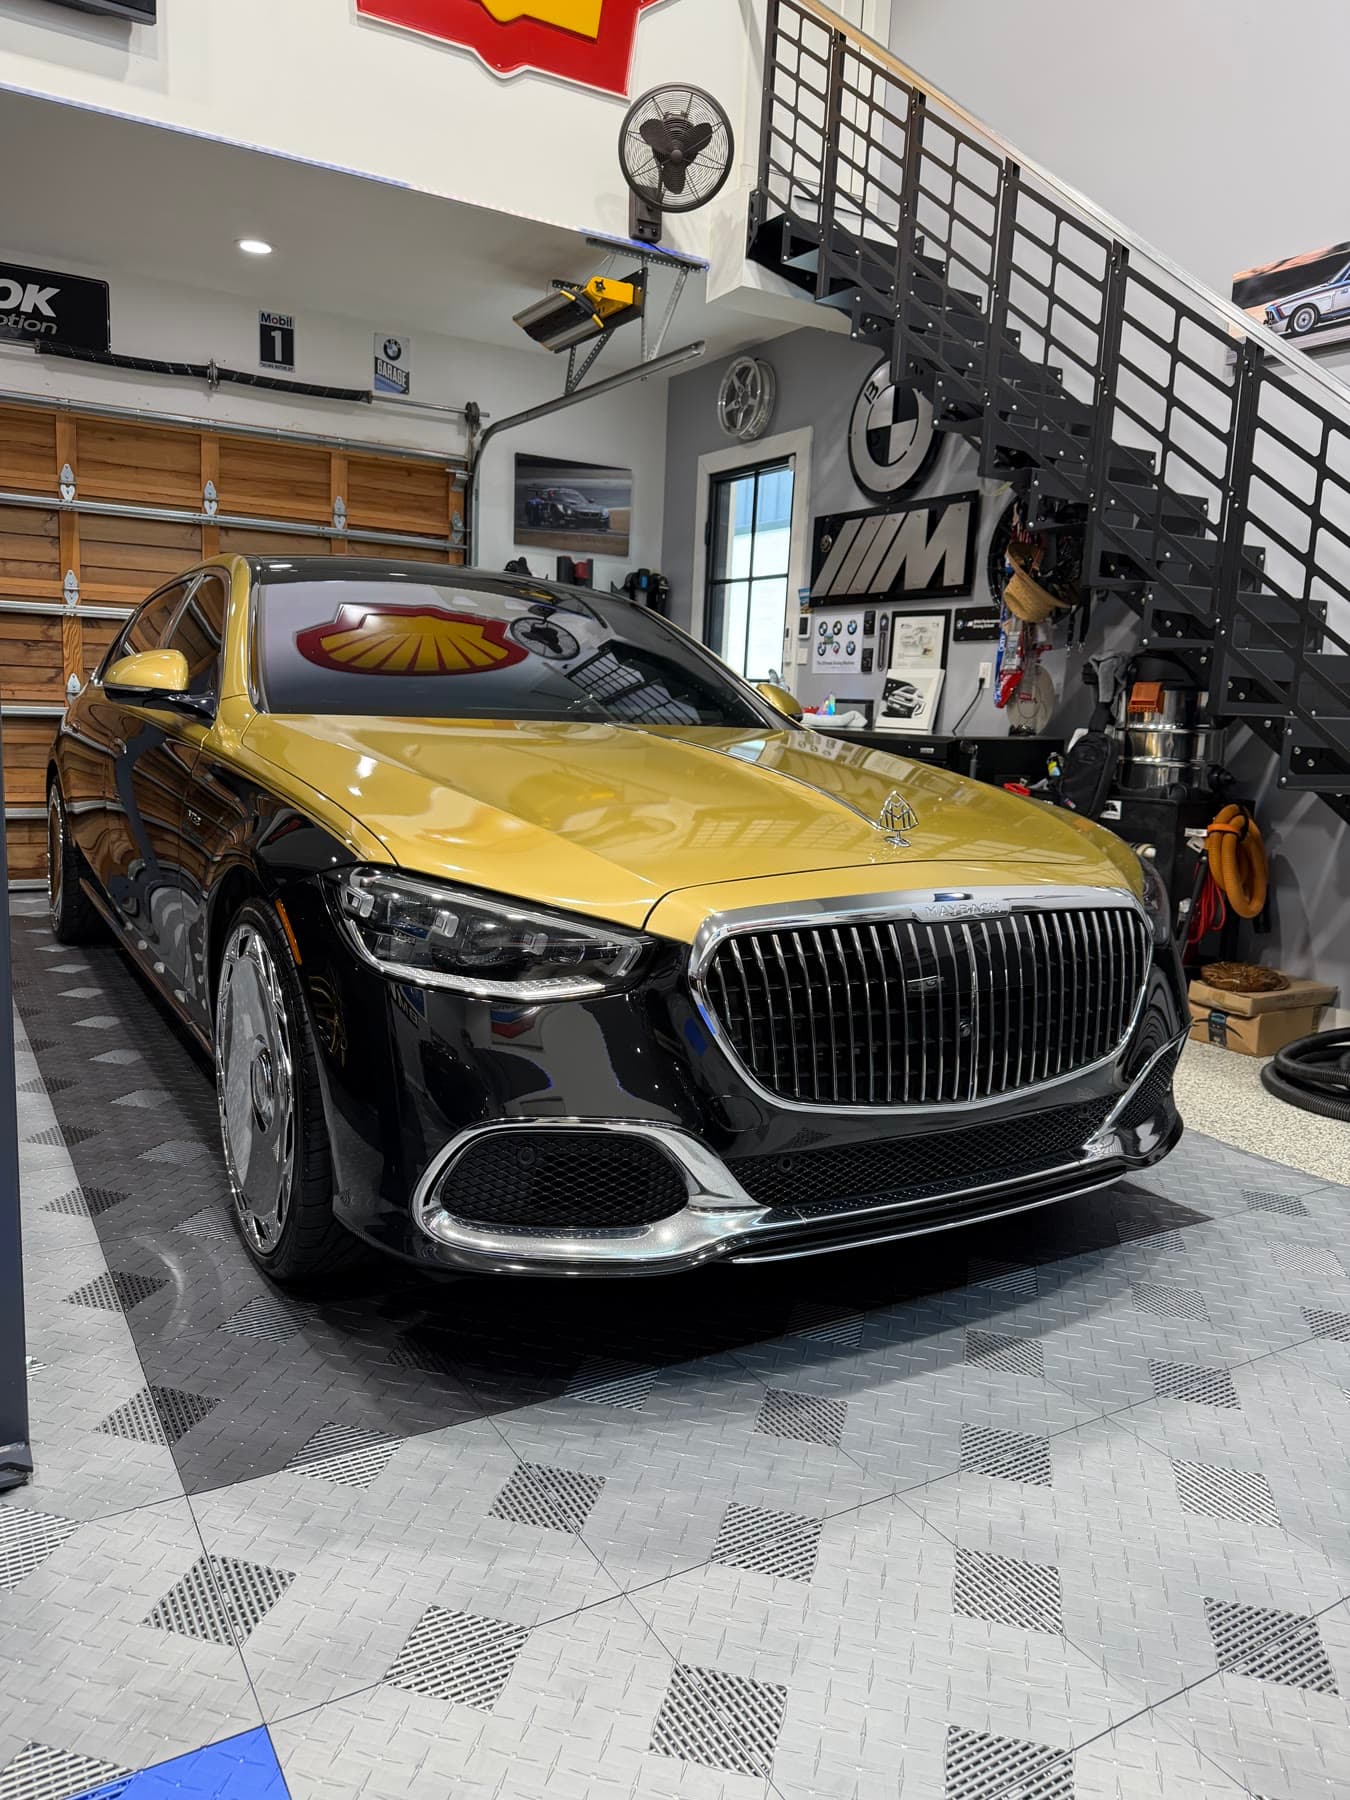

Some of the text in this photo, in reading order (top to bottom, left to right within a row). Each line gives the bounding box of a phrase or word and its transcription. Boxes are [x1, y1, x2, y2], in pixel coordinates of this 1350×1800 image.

[261, 312, 293, 328] Mobil
[271, 330, 282, 361] 1
[377, 359, 407, 388] GARAGE
[925, 901, 1002, 918] MAYBACH
